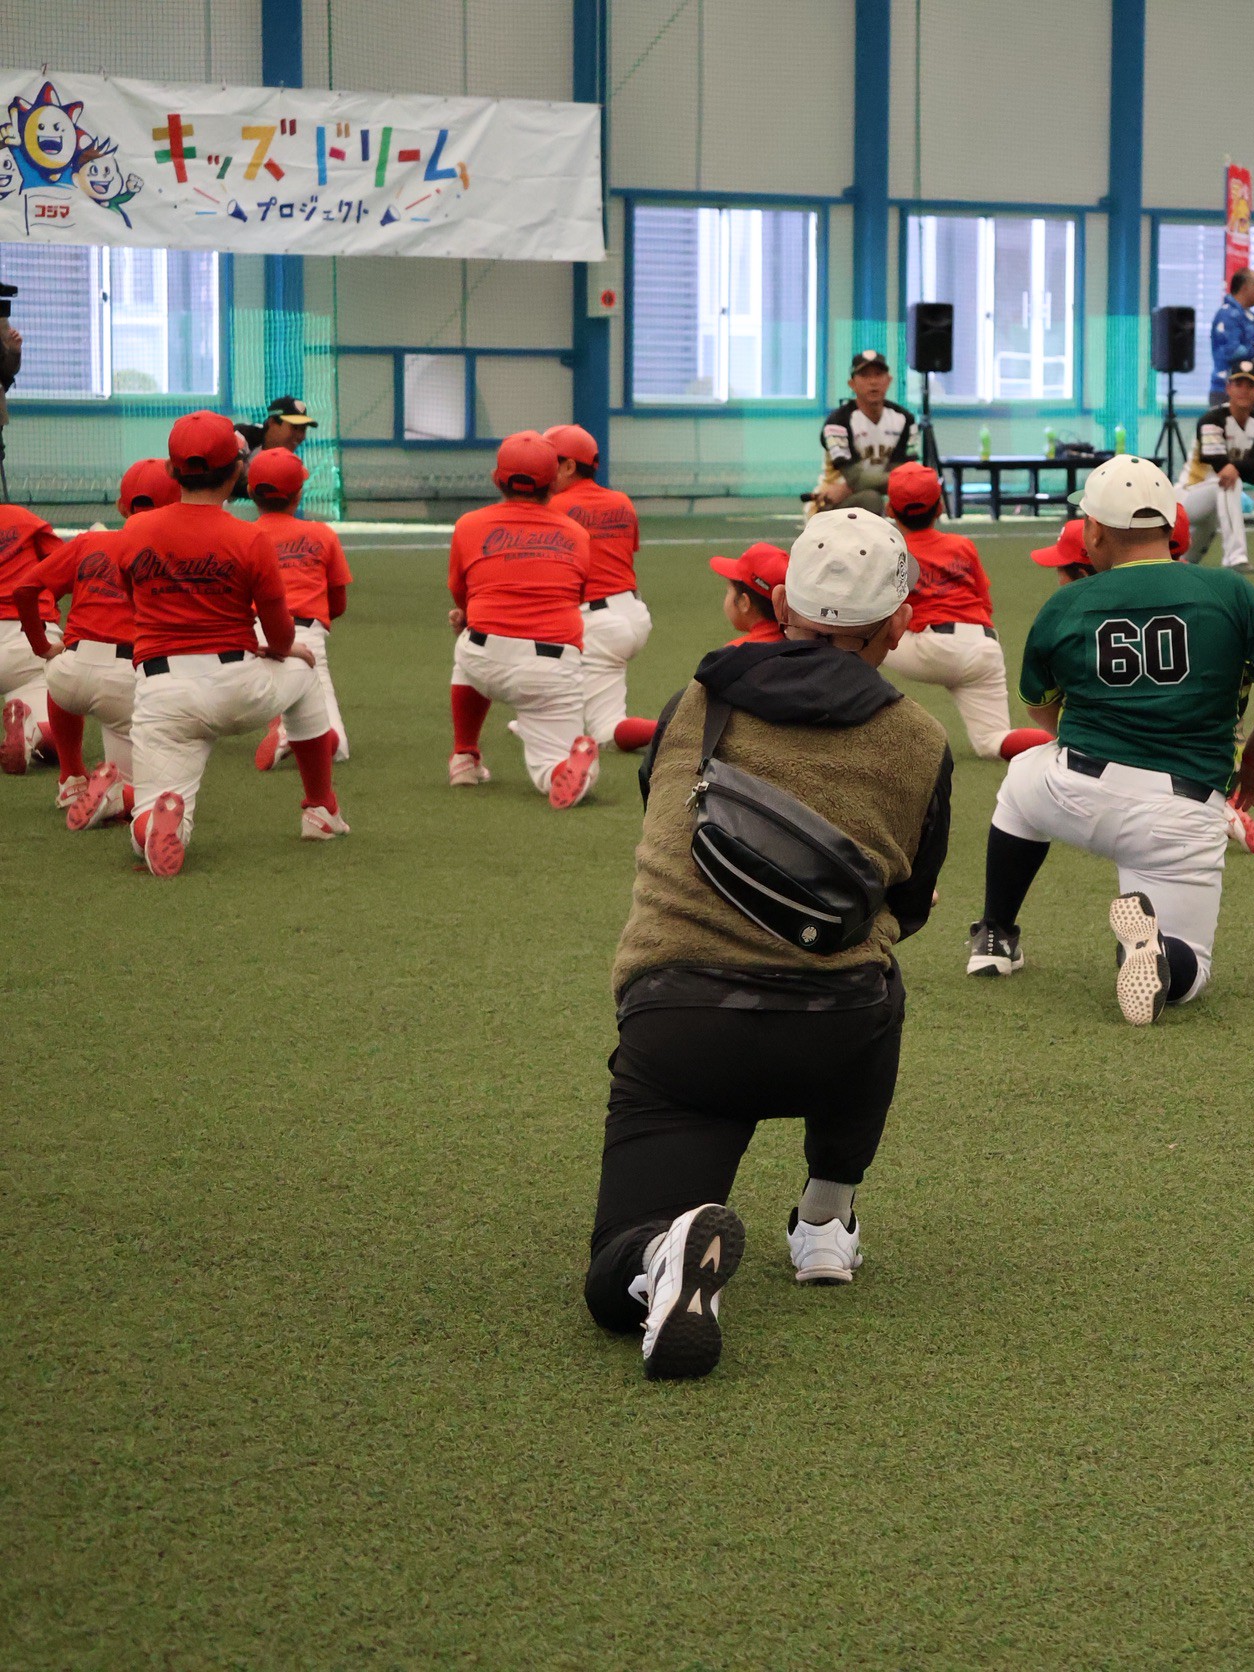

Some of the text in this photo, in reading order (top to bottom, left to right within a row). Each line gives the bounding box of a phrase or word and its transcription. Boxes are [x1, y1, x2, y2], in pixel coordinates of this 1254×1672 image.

[35, 205, 70, 219] コジマ
[257, 195, 369, 222] プロジェクト
[130, 547, 235, 586] Chizuka
[1096, 614, 1190, 687] 60
